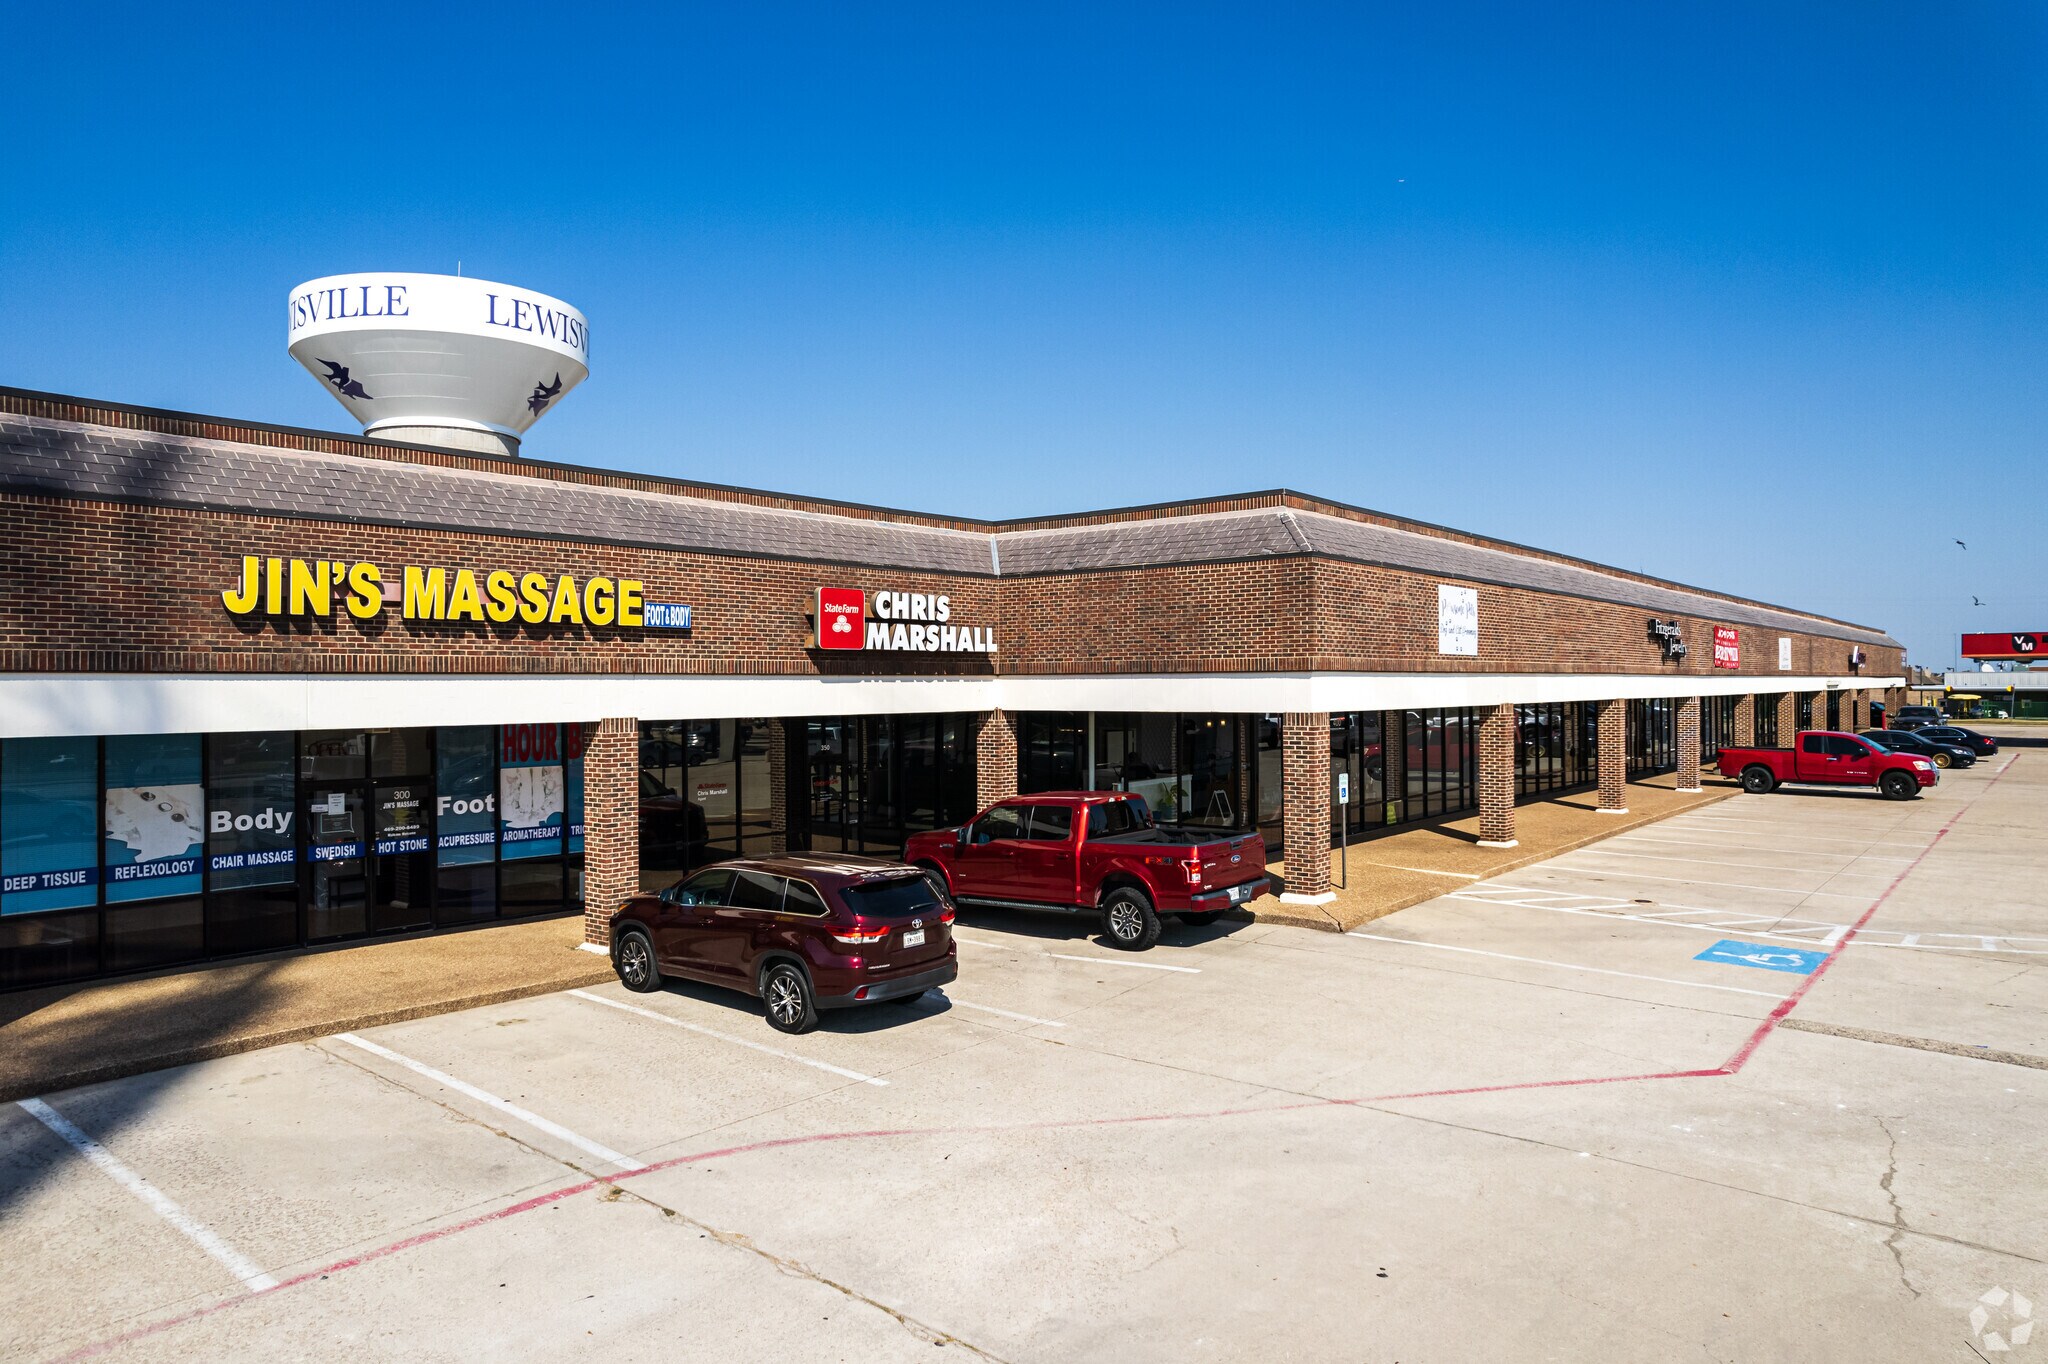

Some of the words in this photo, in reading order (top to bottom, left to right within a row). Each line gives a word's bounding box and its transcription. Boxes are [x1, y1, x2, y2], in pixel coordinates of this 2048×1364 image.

[290, 285, 409, 332] ISVILLE
[222, 556, 382, 619] JIN'S
[403, 566, 644, 627] MASSAGE
[646, 604, 666, 626] FOOT
[670, 605, 690, 627] BODY
[875, 591, 950, 622] CHRIS
[866, 622, 998, 652] MARSHALL
[503, 724, 558, 762] HOUR
[394, 790, 410, 800] 300
[396, 800, 419, 808] MASSAGE
[437, 794, 495, 816] Foot
[210, 808, 293, 834] Body
[438, 832, 495, 848] ACUPRESSURE
[503, 827, 561, 842] AROMATHERAPY
[315, 845, 356, 859] SWEDISH
[378, 841, 396, 853] HOT
[400, 839, 427, 851] STONE
[212, 855, 244, 869] CHAIR
[247, 850, 294, 866] MASSAGE
[115, 860, 195, 880] REFLEXOLOGY
[4, 876, 37, 891] DEEP
[42, 871, 86, 887] TISSUE
